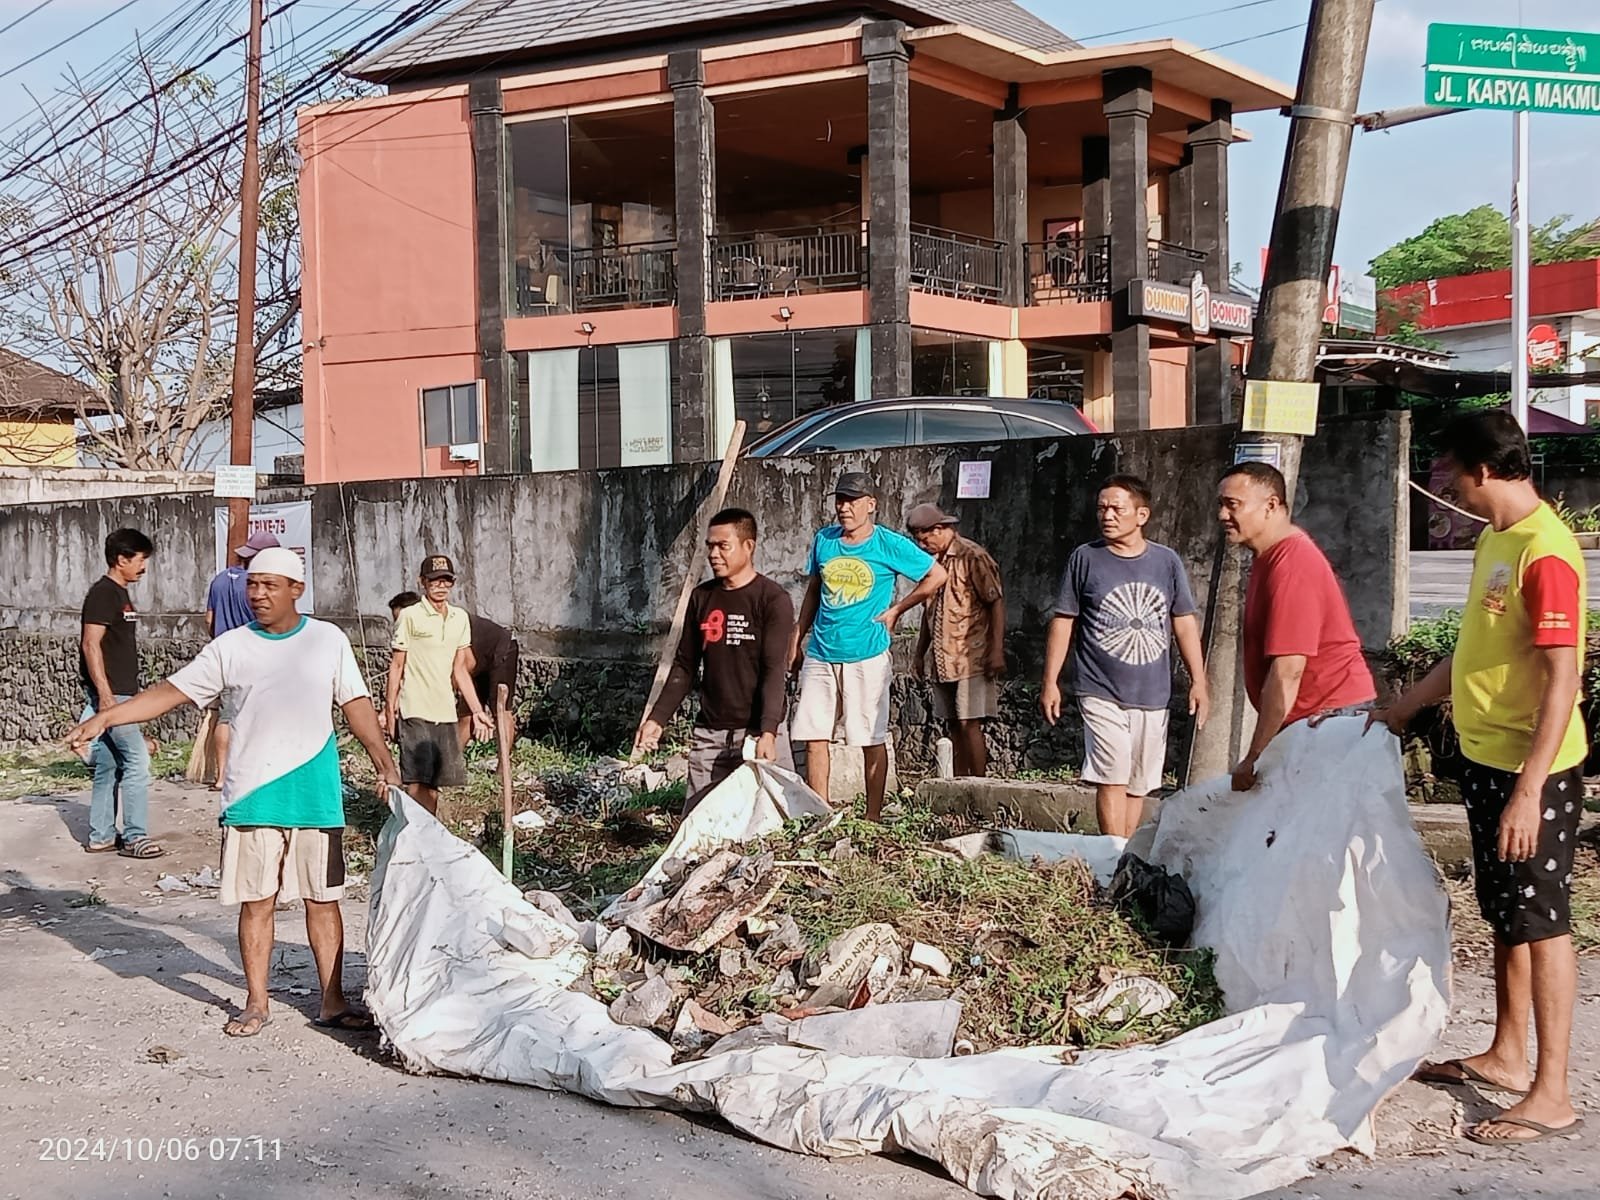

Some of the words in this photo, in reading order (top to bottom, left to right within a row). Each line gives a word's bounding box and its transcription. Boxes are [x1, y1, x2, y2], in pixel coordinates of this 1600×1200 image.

[1434, 76, 1462, 102] JL.
[1467, 77, 1530, 107] KARYA
[1210, 299, 1252, 329] DONUTS
[851, 924, 882, 958] SEMEN
